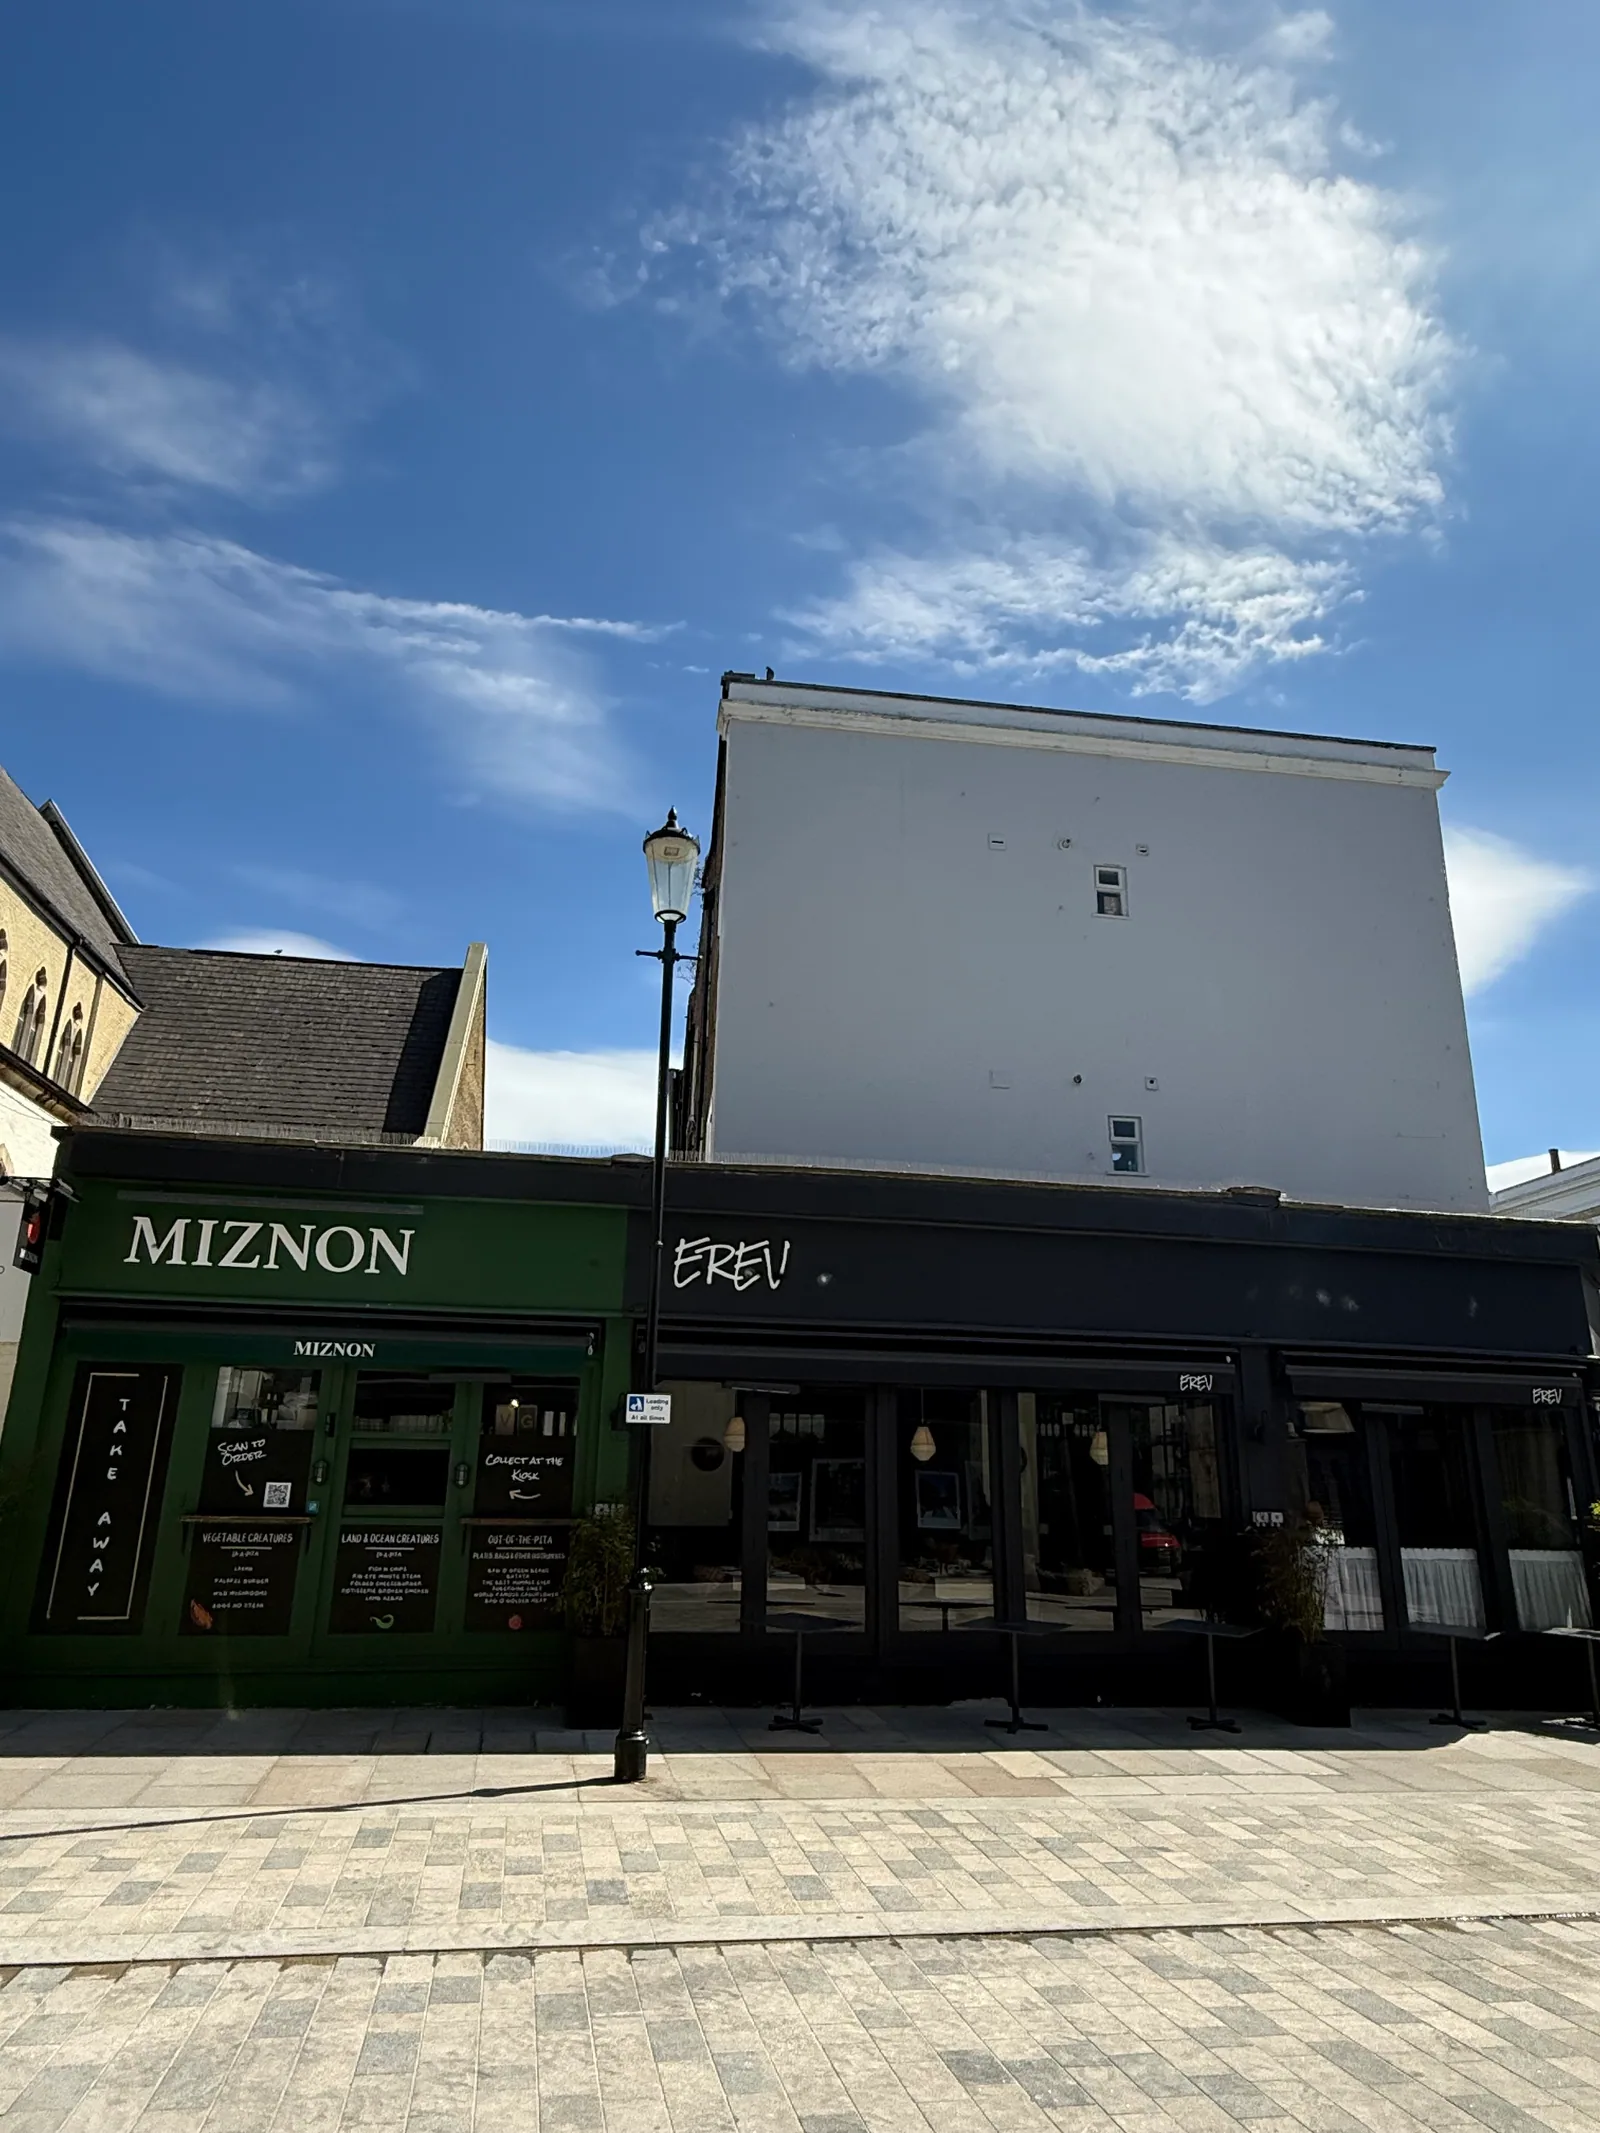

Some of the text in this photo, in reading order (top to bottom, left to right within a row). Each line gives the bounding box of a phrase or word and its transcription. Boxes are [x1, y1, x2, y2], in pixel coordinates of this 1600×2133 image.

[123, 1215, 416, 1277] MIZNON
[673, 1236, 792, 1291] EREV
[293, 1340, 376, 1359] MIZNON
[1179, 1373, 1214, 1392] EREV
[1532, 1387, 1563, 1405] EREV
[217, 1439, 266, 1454] SCAN TO
[221, 1450, 268, 1466] ORDER
[485, 1454, 564, 1466] COLLECT AT THE
[511, 1468, 540, 1482] KIOSK
[87, 1398, 131, 1596] TAKE AWAY
[202, 1532, 294, 1544] VEGETABLE CREATURES
[341, 1533, 440, 1544] LAND & OCEAN CREATURES
